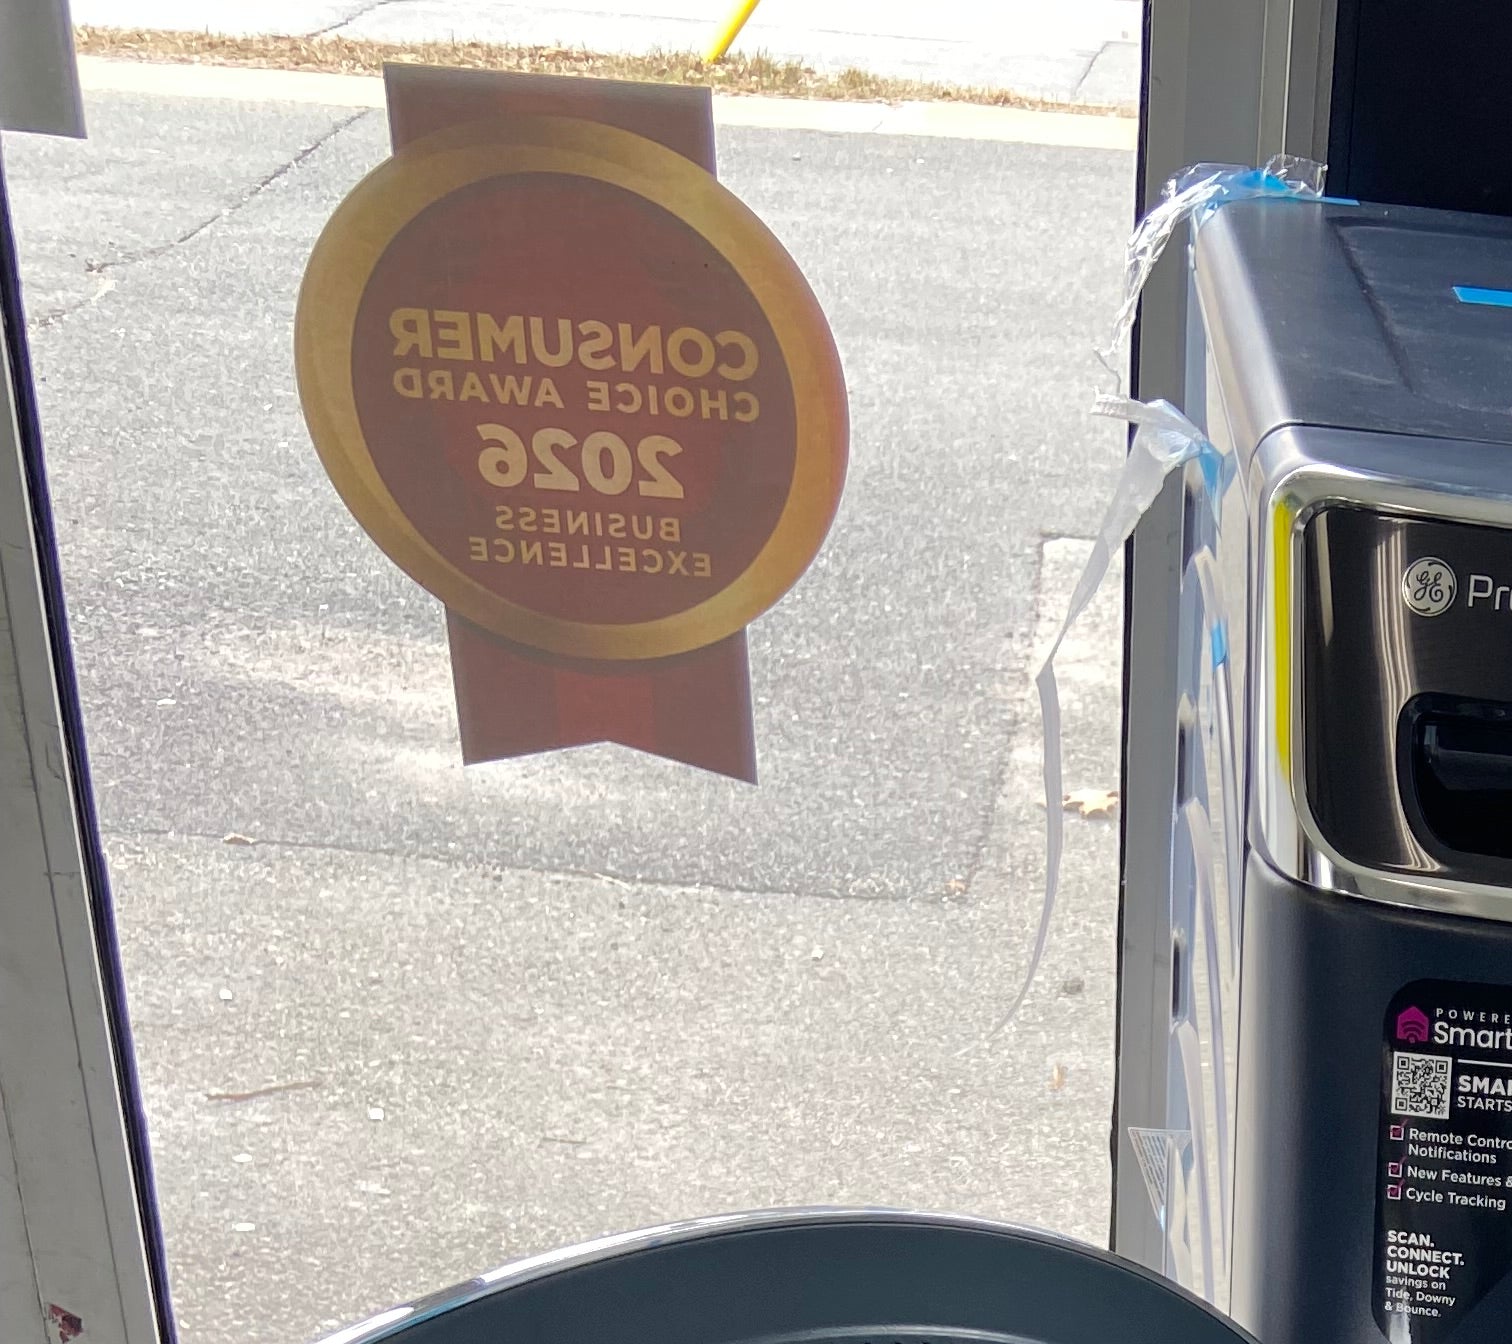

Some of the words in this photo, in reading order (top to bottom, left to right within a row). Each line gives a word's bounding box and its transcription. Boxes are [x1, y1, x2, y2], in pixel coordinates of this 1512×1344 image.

[1457, 1096, 1512, 1113] STARTS
[1409, 1128, 1463, 1145] Remote
[1408, 1143, 1497, 1164] Notifications
[1407, 1166, 1437, 1182] New
[1441, 1169, 1502, 1188] Features
[1406, 1187, 1444, 1205] Cycle
[1447, 1192, 1506, 1211] Tracking
[1387, 1230, 1435, 1247] SCAN.
[1387, 1245, 1465, 1266] CONNECT.
[1386, 1259, 1451, 1280] UNLOCK
[1386, 1276, 1428, 1290] savings
[1431, 1281, 1446, 1290] on
[1385, 1288, 1414, 1302] Tide,
[1416, 1292, 1455, 1307] Downy
